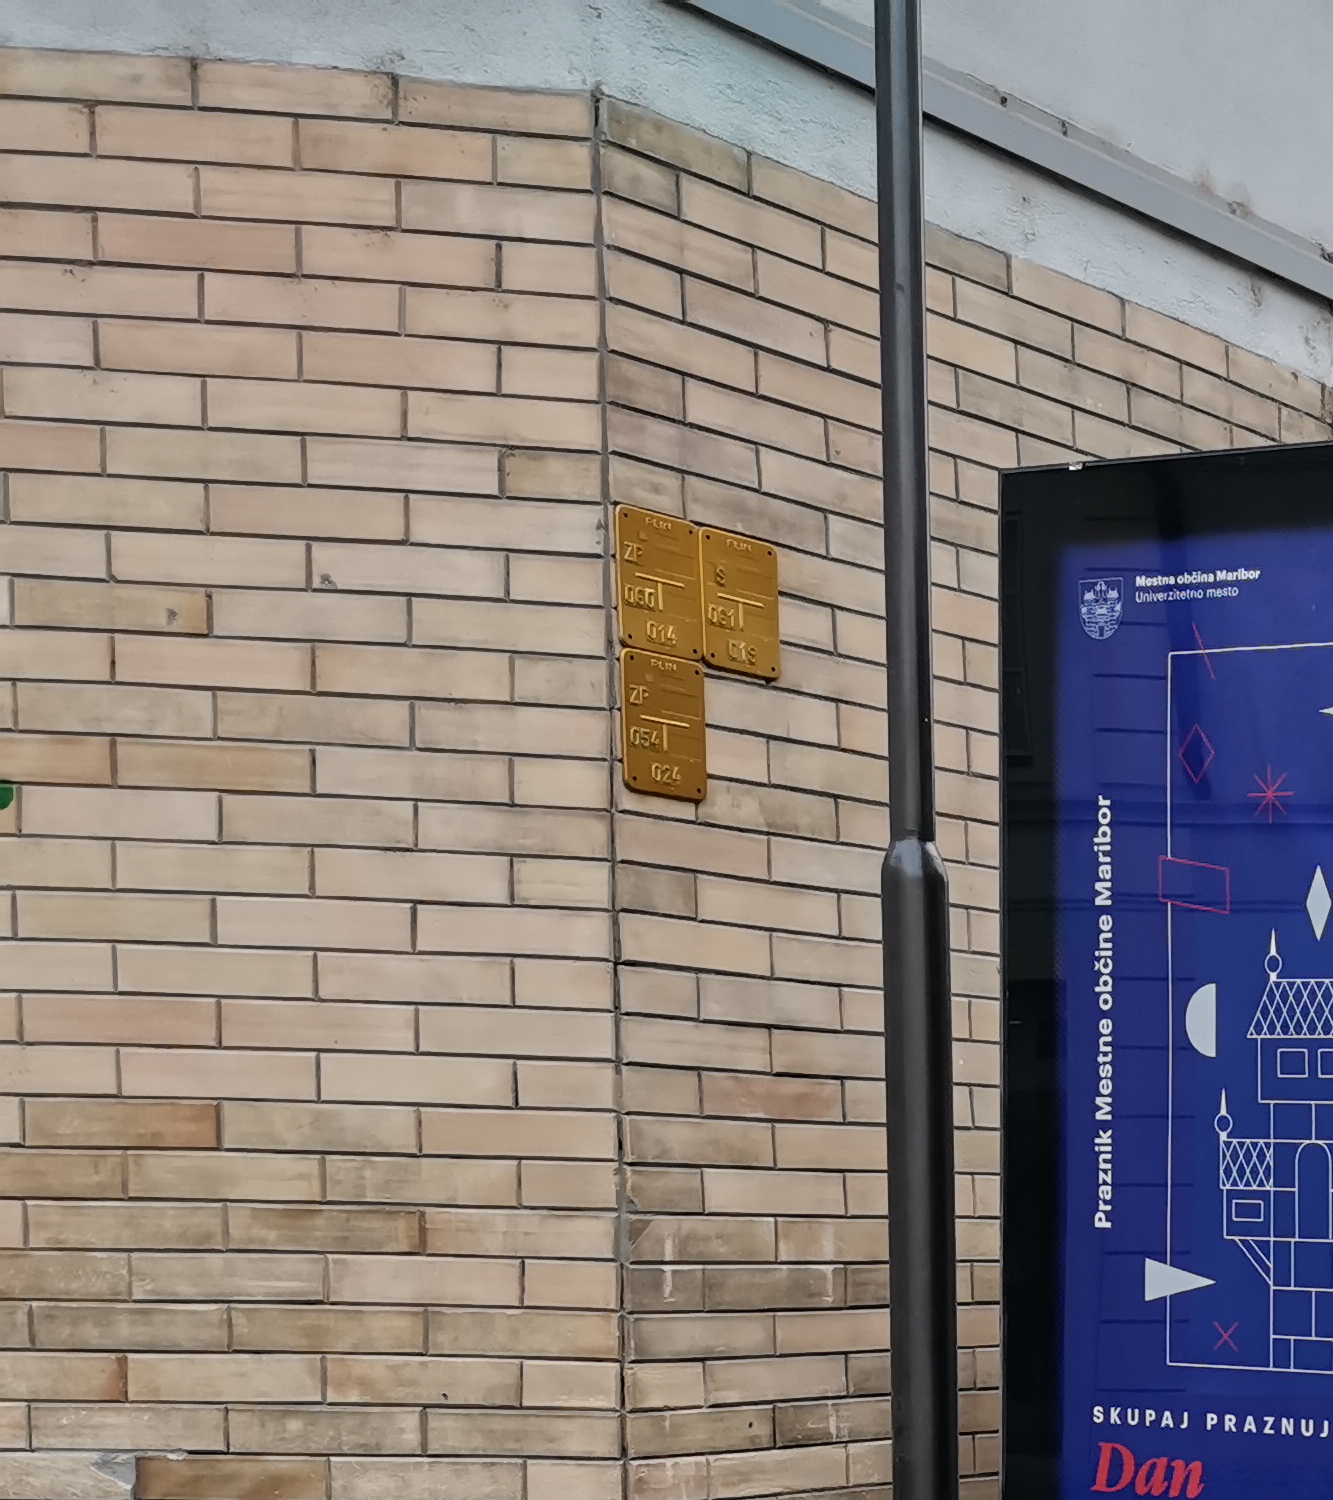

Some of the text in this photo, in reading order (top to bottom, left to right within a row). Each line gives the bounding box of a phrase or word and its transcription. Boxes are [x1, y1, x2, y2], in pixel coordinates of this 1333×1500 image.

[1135, 568, 1261, 588] Mestna občina Maribor
[1135, 586, 1239, 604] Univerzitetno mesto
[1093, 795, 1113, 1229] Praznik Mestne občine Maribor
[1092, 1405, 1190, 1430] SKUPAJ
[1090, 1441, 1205, 1499] Dan
